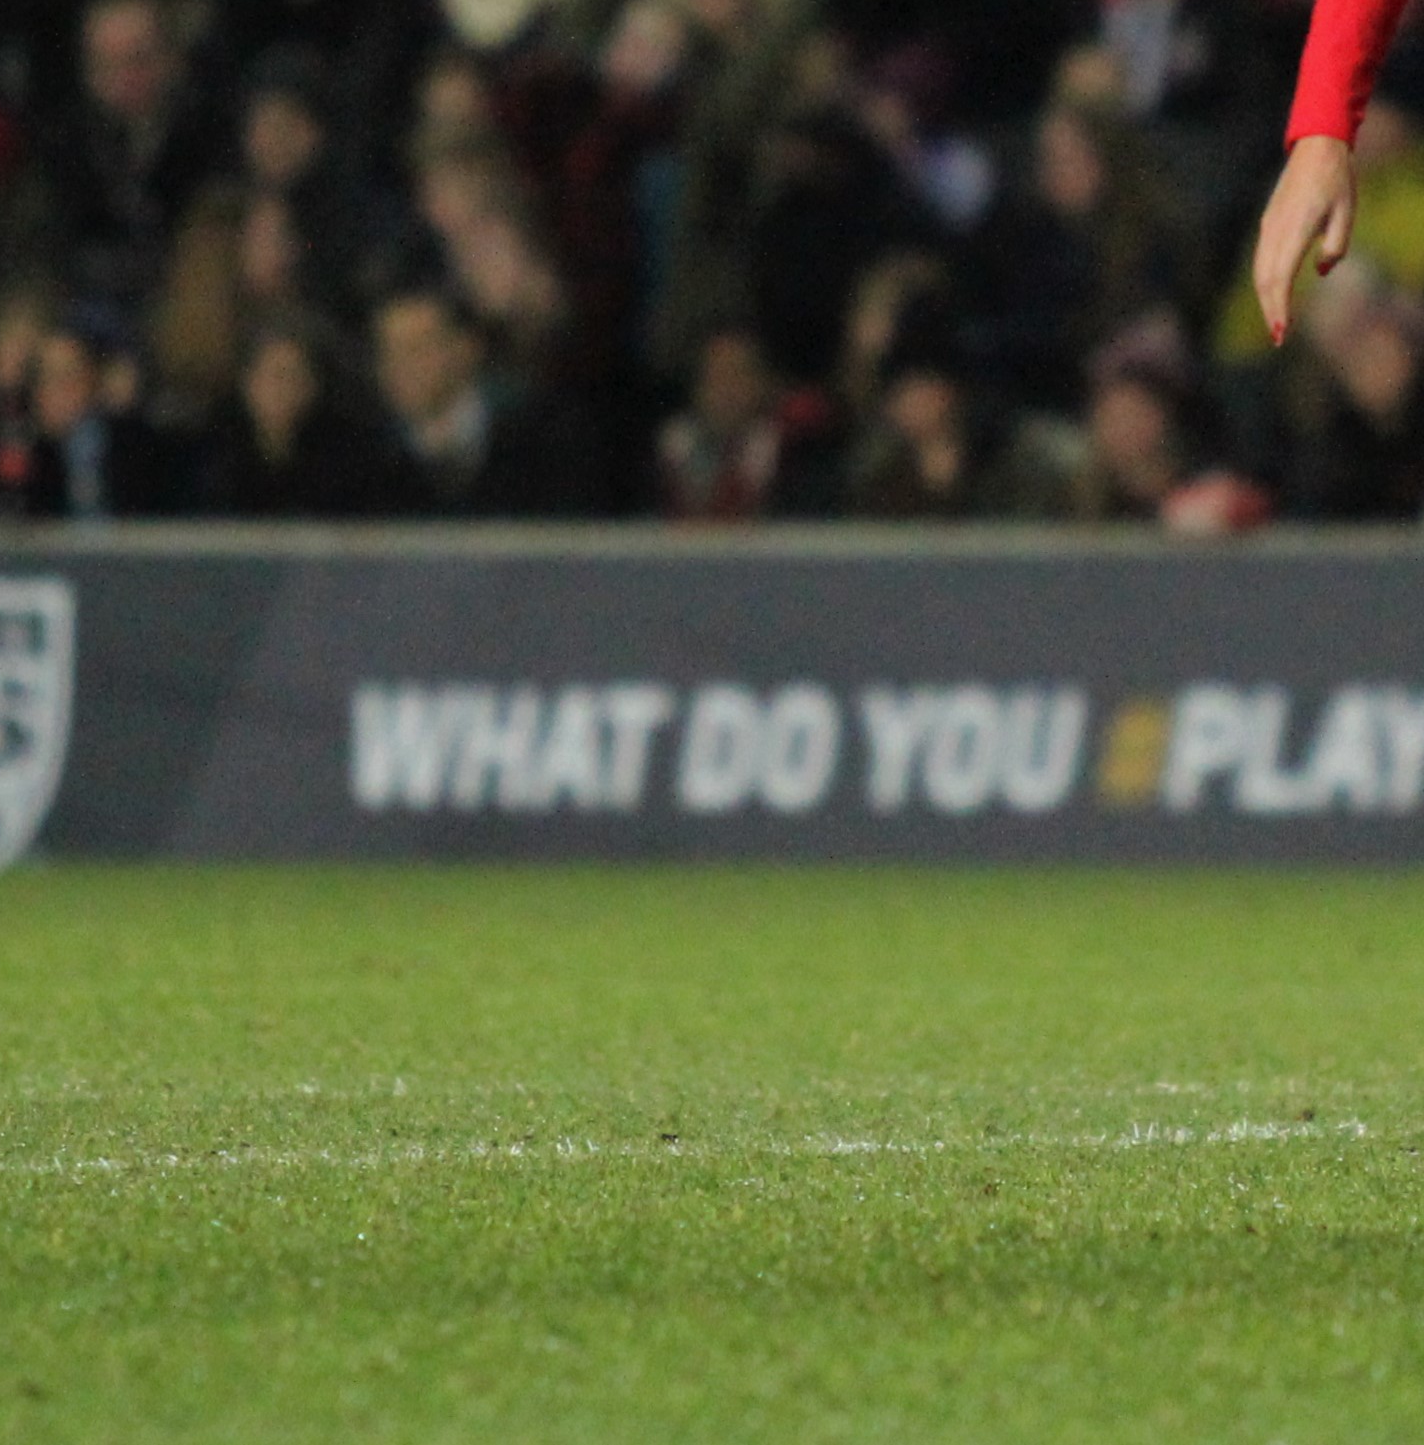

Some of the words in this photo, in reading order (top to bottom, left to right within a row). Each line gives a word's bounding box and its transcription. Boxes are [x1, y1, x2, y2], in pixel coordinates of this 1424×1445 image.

[351, 682, 673, 812] WHAT
[676, 682, 844, 814] DO
[860, 682, 1090, 814] YOU
